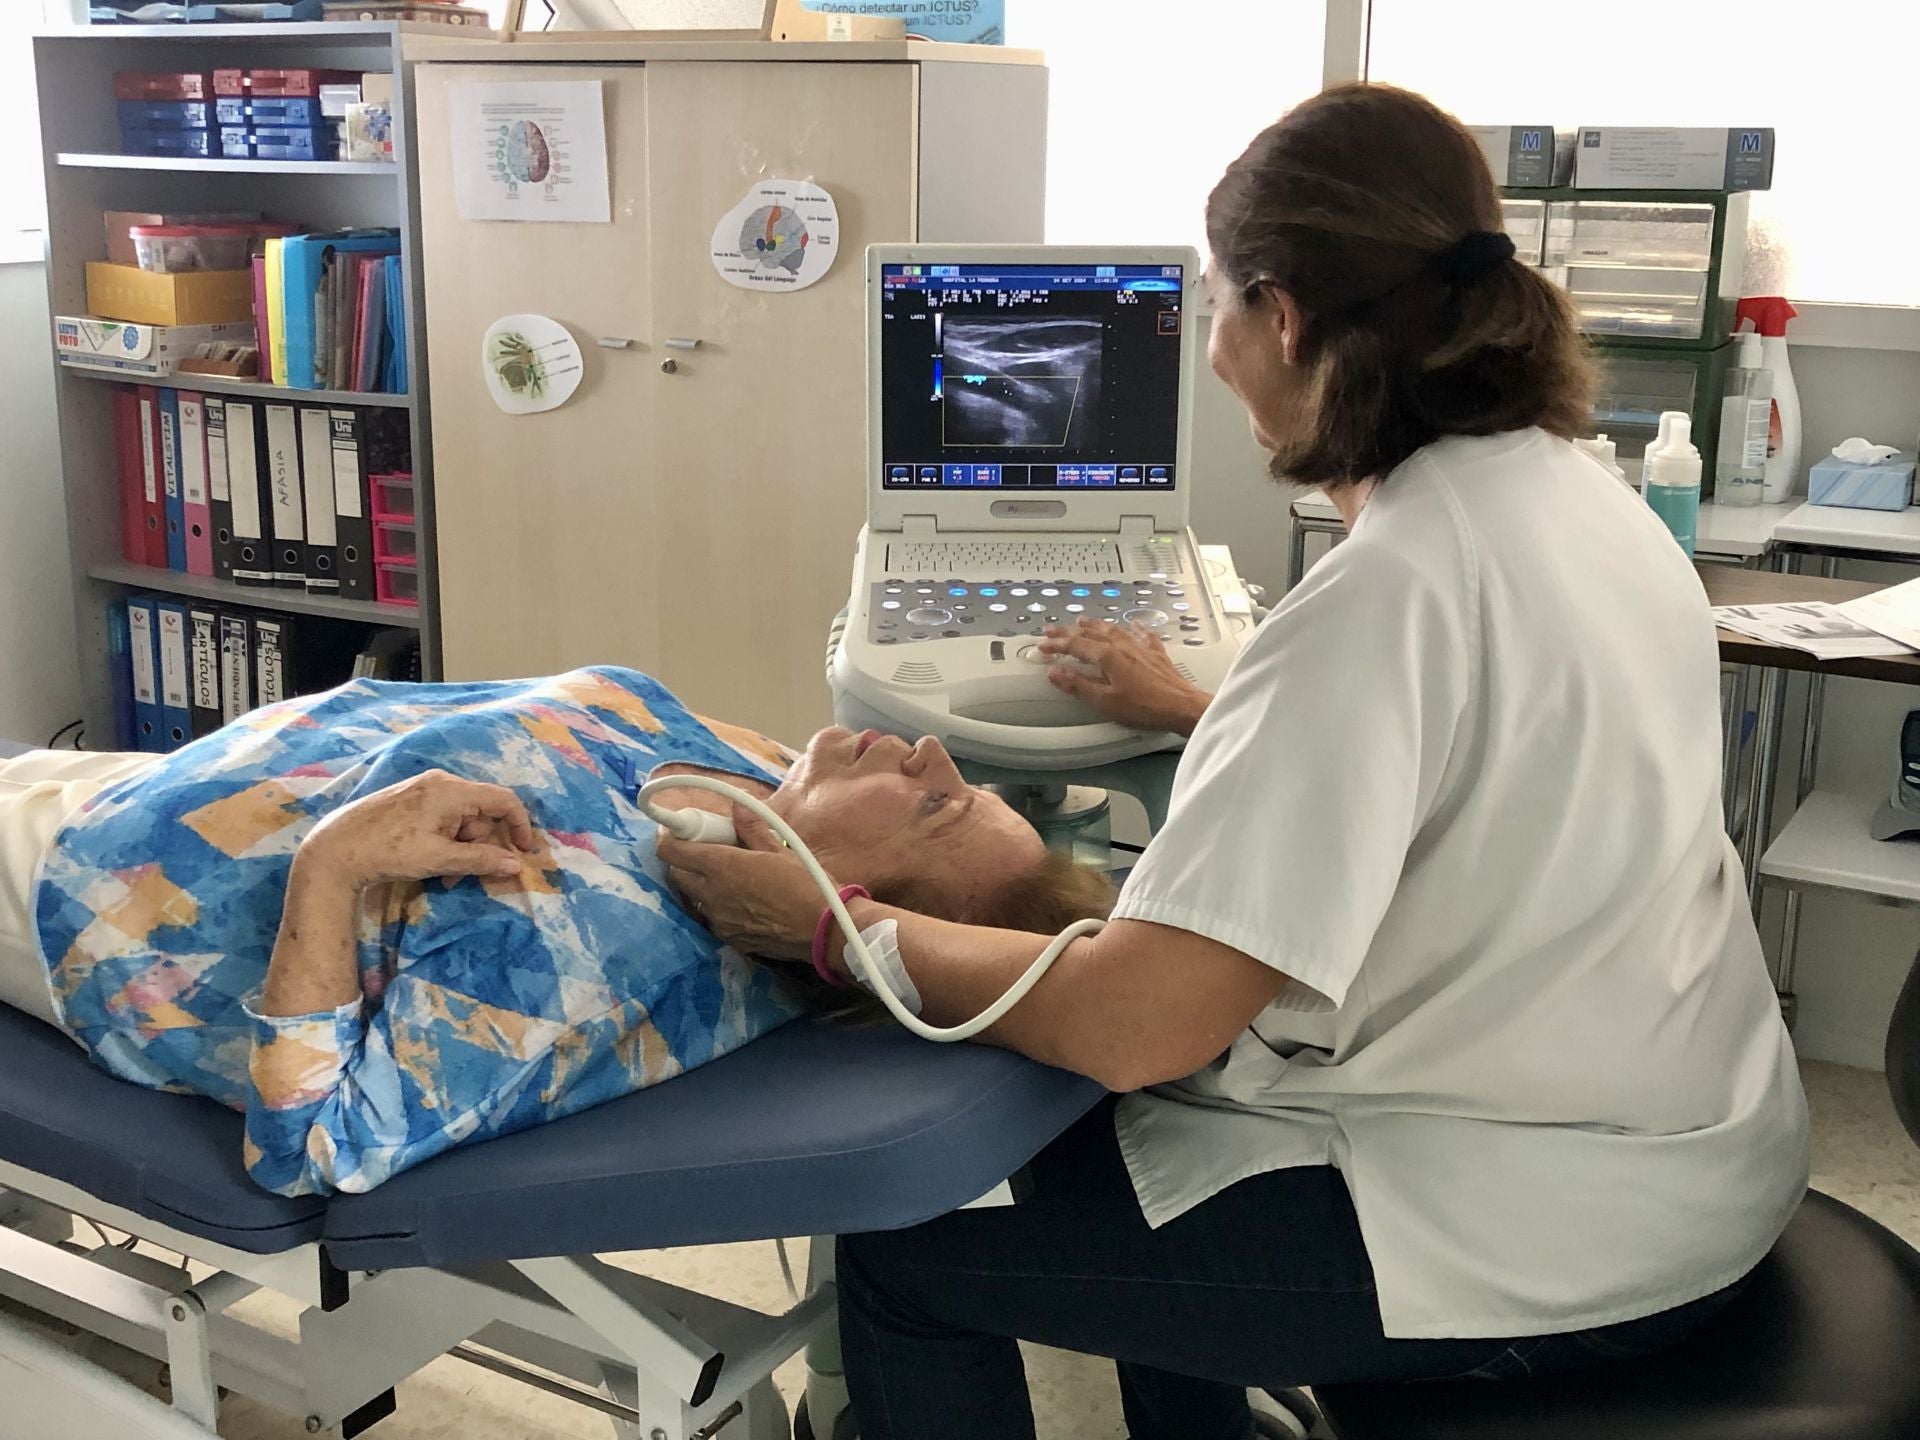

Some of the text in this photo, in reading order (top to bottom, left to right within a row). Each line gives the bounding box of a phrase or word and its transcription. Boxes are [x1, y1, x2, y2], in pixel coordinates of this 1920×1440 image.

[860, 2, 907, 14] detectar
[911, 4, 925, 13] un
[930, 0, 979, 12] ICTUS?
[924, 14, 972, 26] ICTUS?
[1521, 131, 1540, 151] M
[1739, 132, 1761, 153] M
[58, 335, 79, 346] FOTO
[163, 415, 176, 494] VITALSTIM
[276, 450, 290, 507] AFASIA
